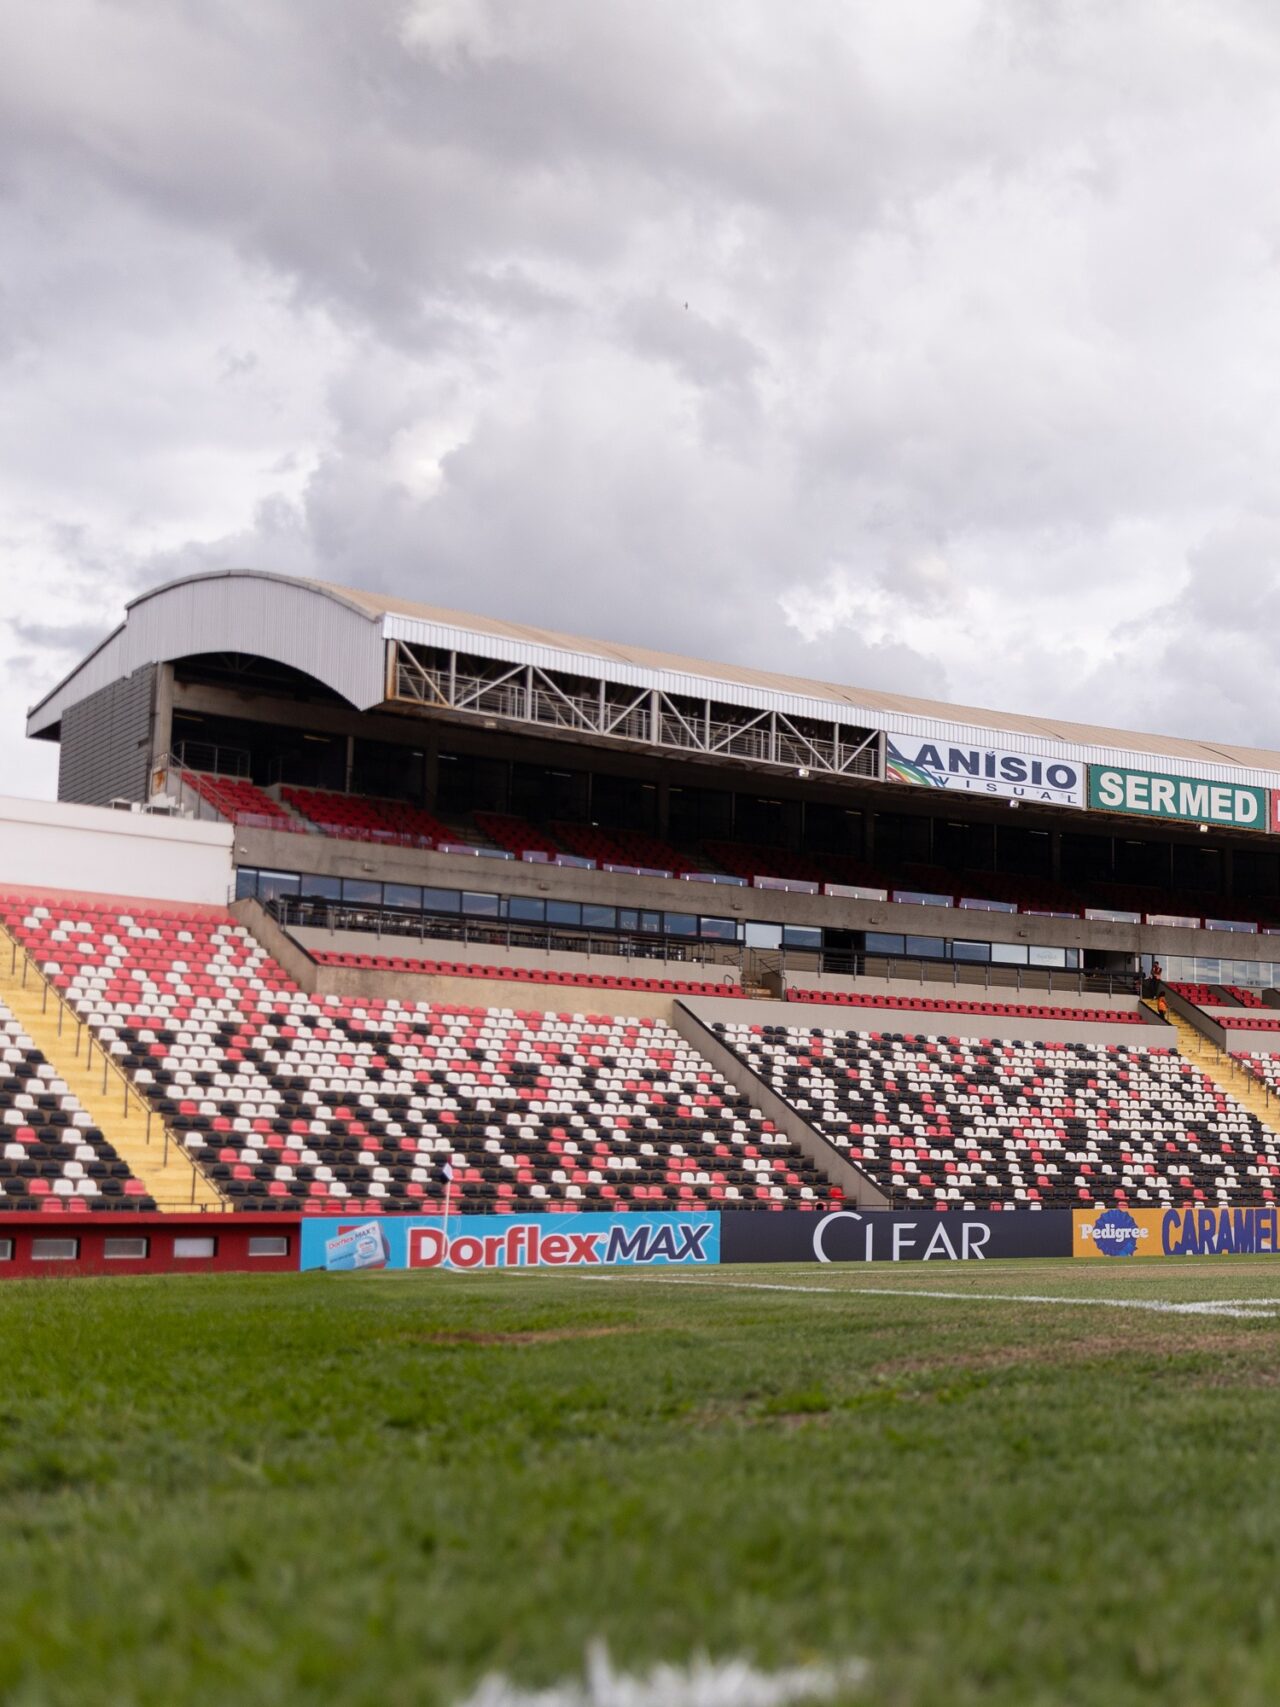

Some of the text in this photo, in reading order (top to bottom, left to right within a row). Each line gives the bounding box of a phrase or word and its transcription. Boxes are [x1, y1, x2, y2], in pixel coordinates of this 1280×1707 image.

[914, 743, 1077, 790] ANÍSIO
[937, 774, 1077, 804] VISUAL
[1098, 771, 1258, 823] SERMED
[605, 1225, 712, 1262] MAX
[1080, 1223, 1150, 1242] Pedigree
